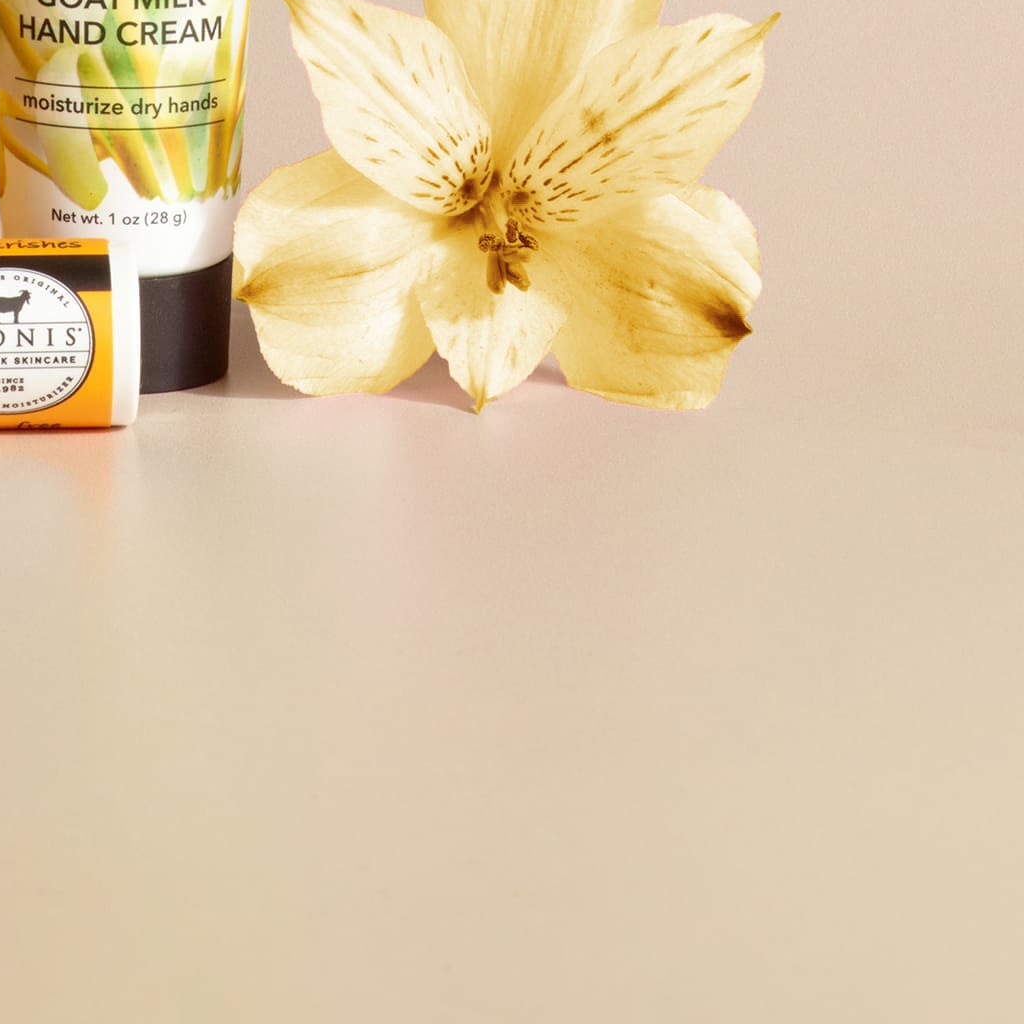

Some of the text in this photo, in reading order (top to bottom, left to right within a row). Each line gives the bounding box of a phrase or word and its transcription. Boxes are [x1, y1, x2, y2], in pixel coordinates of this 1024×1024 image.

[19, 14, 223, 46] HAND CREAM
[23, 91, 218, 119] moisturize dry hands
[51, 208, 188, 227] Net wt. 1 oz (28 g)
[13, 275, 70, 308] ORIGINAL
[14, 356, 77, 365] SKINCARE
[2, 375, 74, 409] MOISTURIZER
